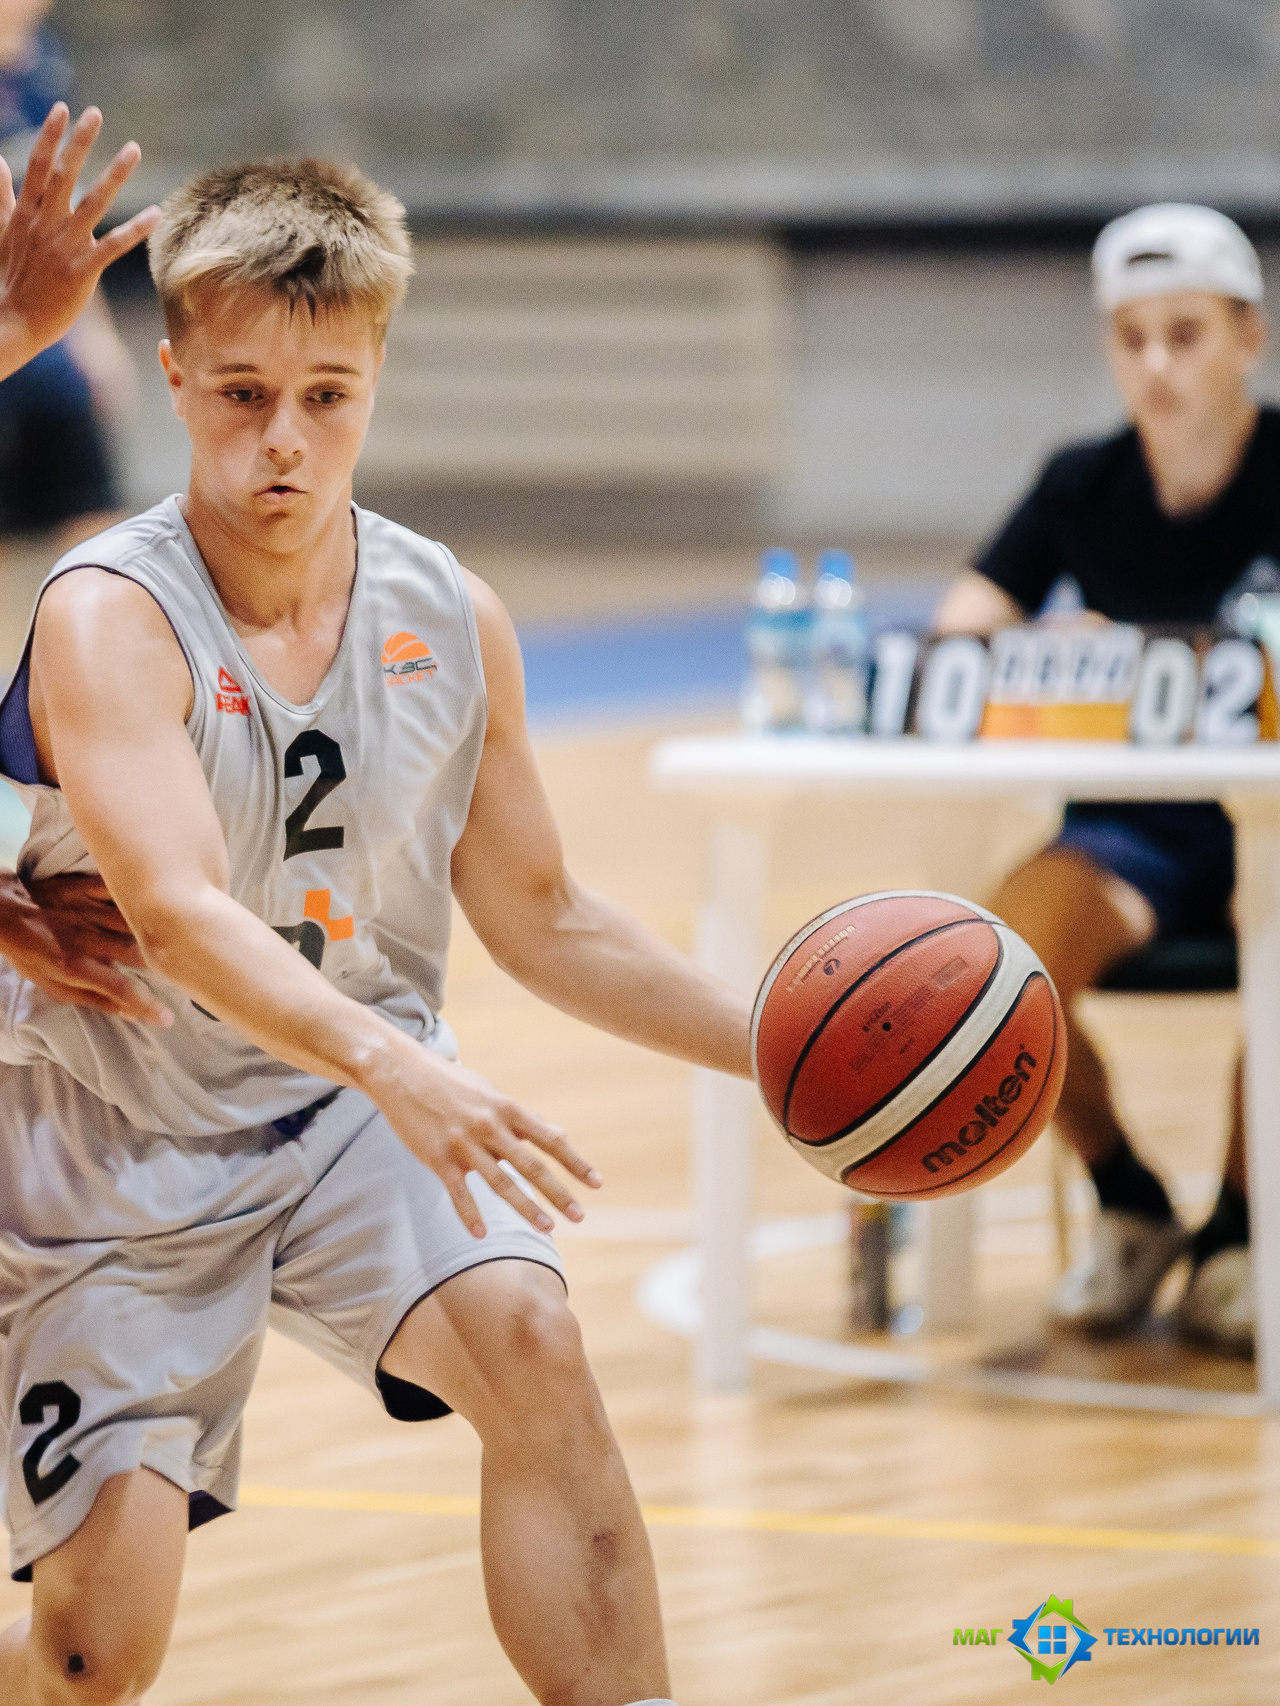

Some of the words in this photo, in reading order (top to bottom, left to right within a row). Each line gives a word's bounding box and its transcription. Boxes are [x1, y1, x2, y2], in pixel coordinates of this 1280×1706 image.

[283, 729, 347, 862] 2
[921, 1051, 1037, 1173] molten
[19, 1380, 82, 1505] 2
